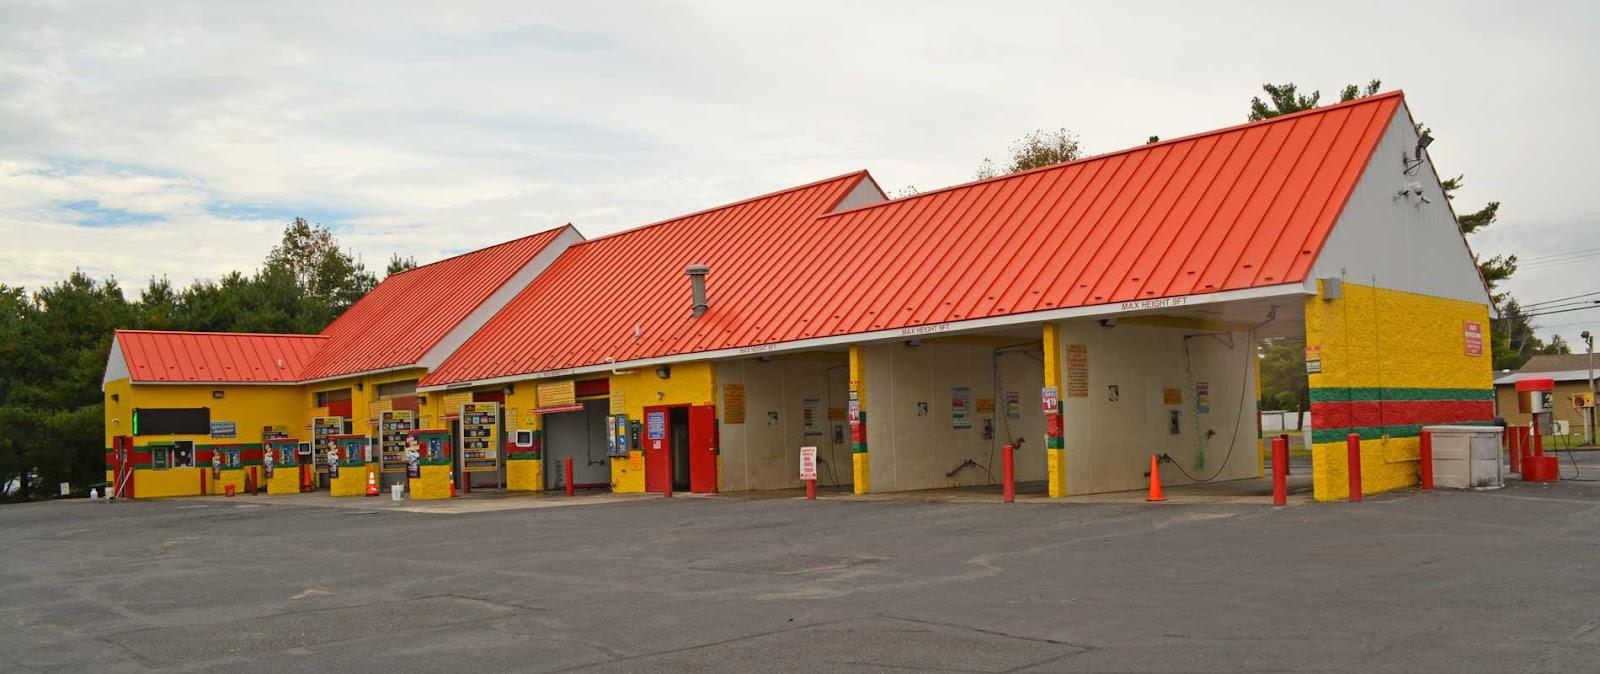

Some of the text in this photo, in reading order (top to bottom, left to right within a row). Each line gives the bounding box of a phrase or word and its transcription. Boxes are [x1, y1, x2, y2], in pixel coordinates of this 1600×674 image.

[1121, 297, 1186, 311] MAX HEIGHT 9FT
[915, 325, 937, 334] HEIGHT
